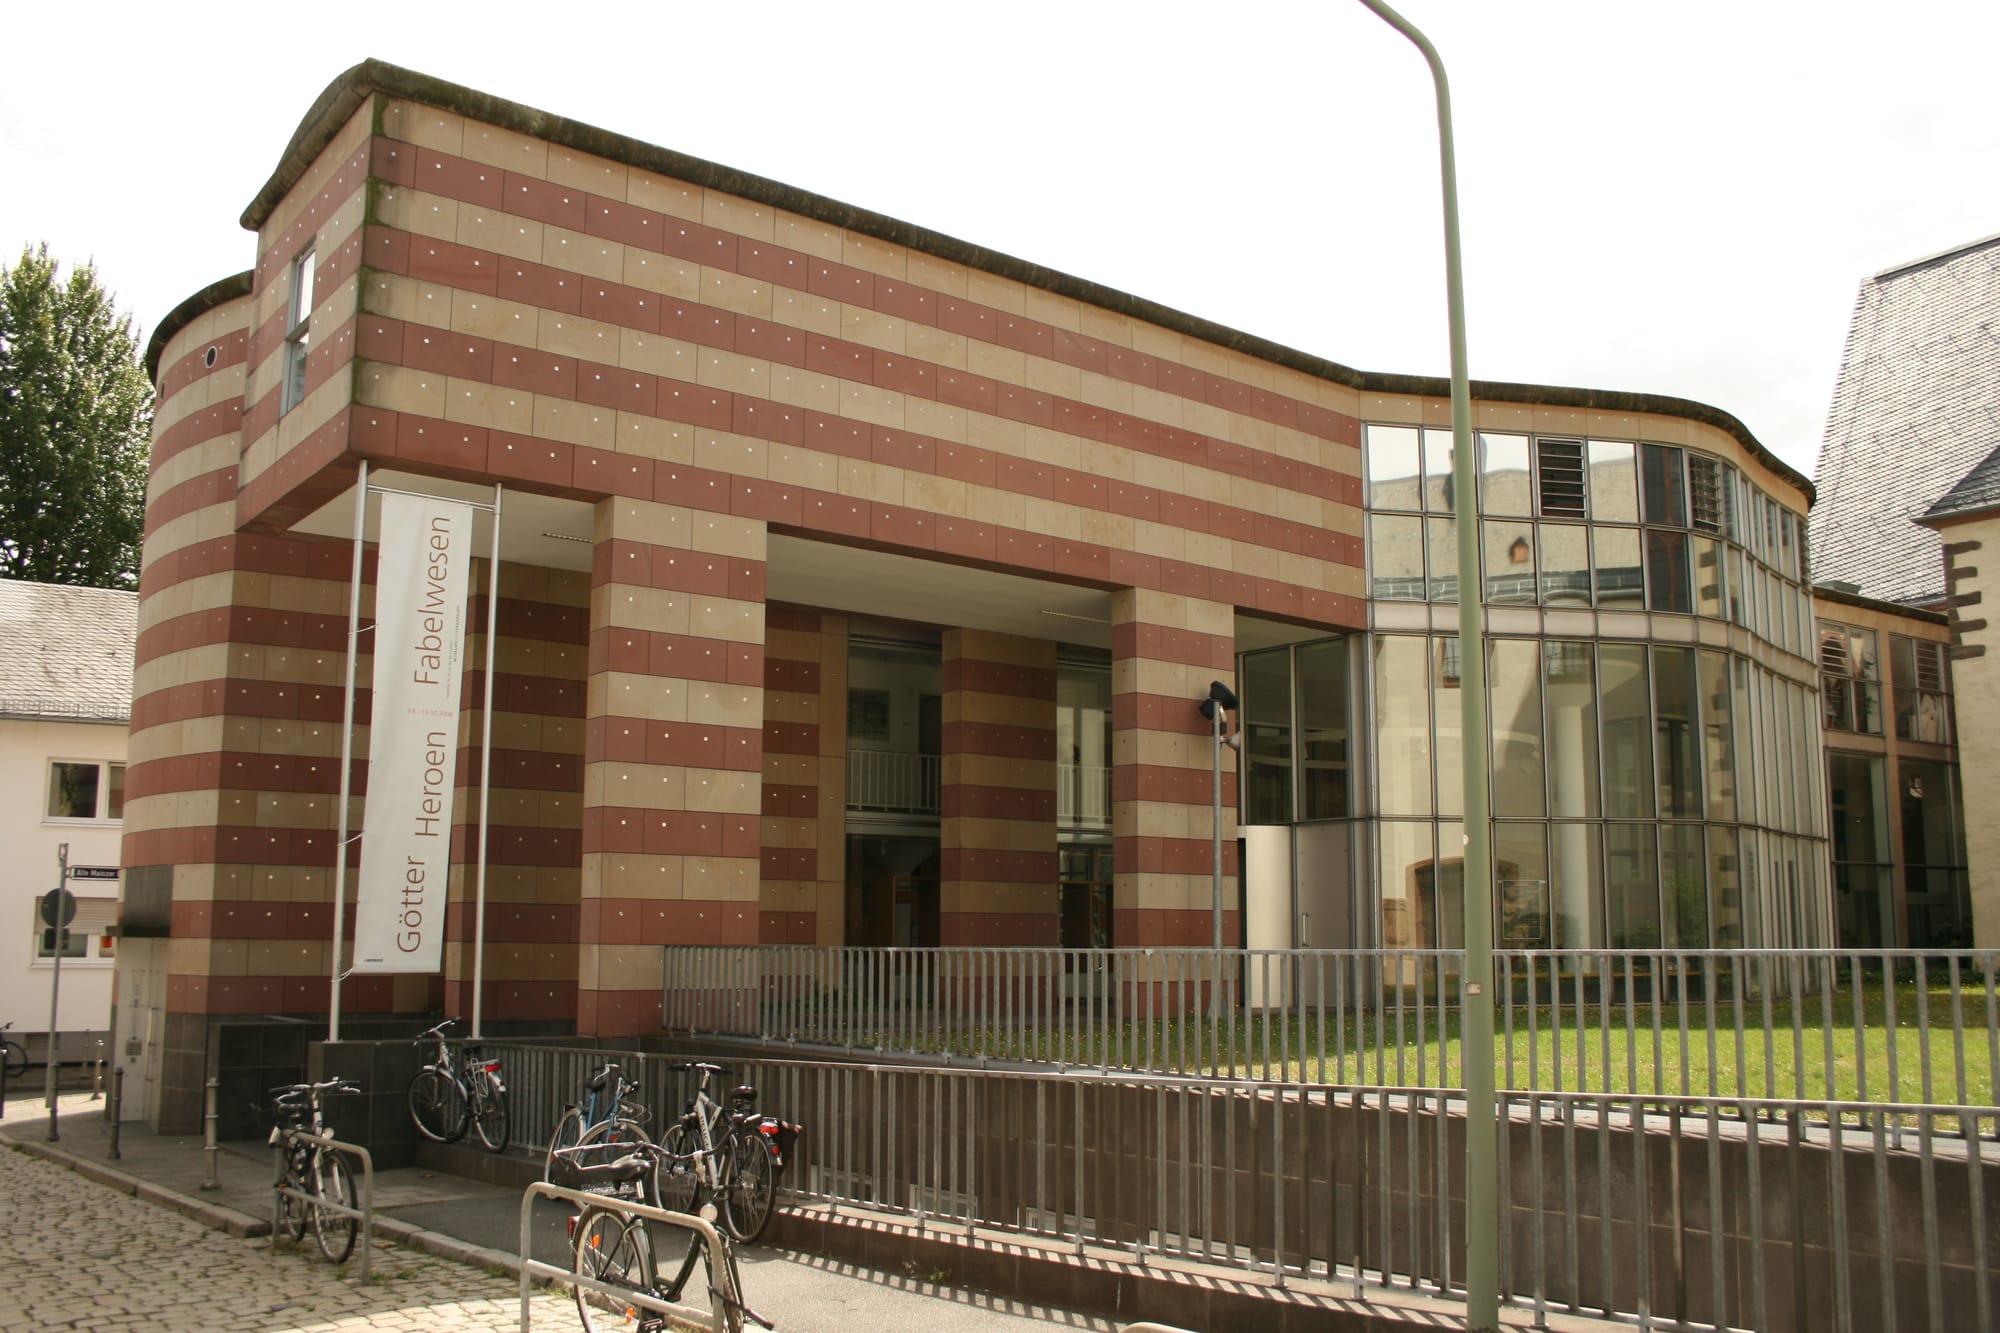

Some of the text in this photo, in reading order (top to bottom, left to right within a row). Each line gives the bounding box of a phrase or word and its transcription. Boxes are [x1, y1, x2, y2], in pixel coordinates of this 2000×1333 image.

[414, 516, 451, 685] Fabelwesen
[414, 731, 447, 837] Heroen
[76, 869, 89, 877] Alte
[91, 869, 116, 877] Mainzer
[397, 855, 426, 953] Götter
